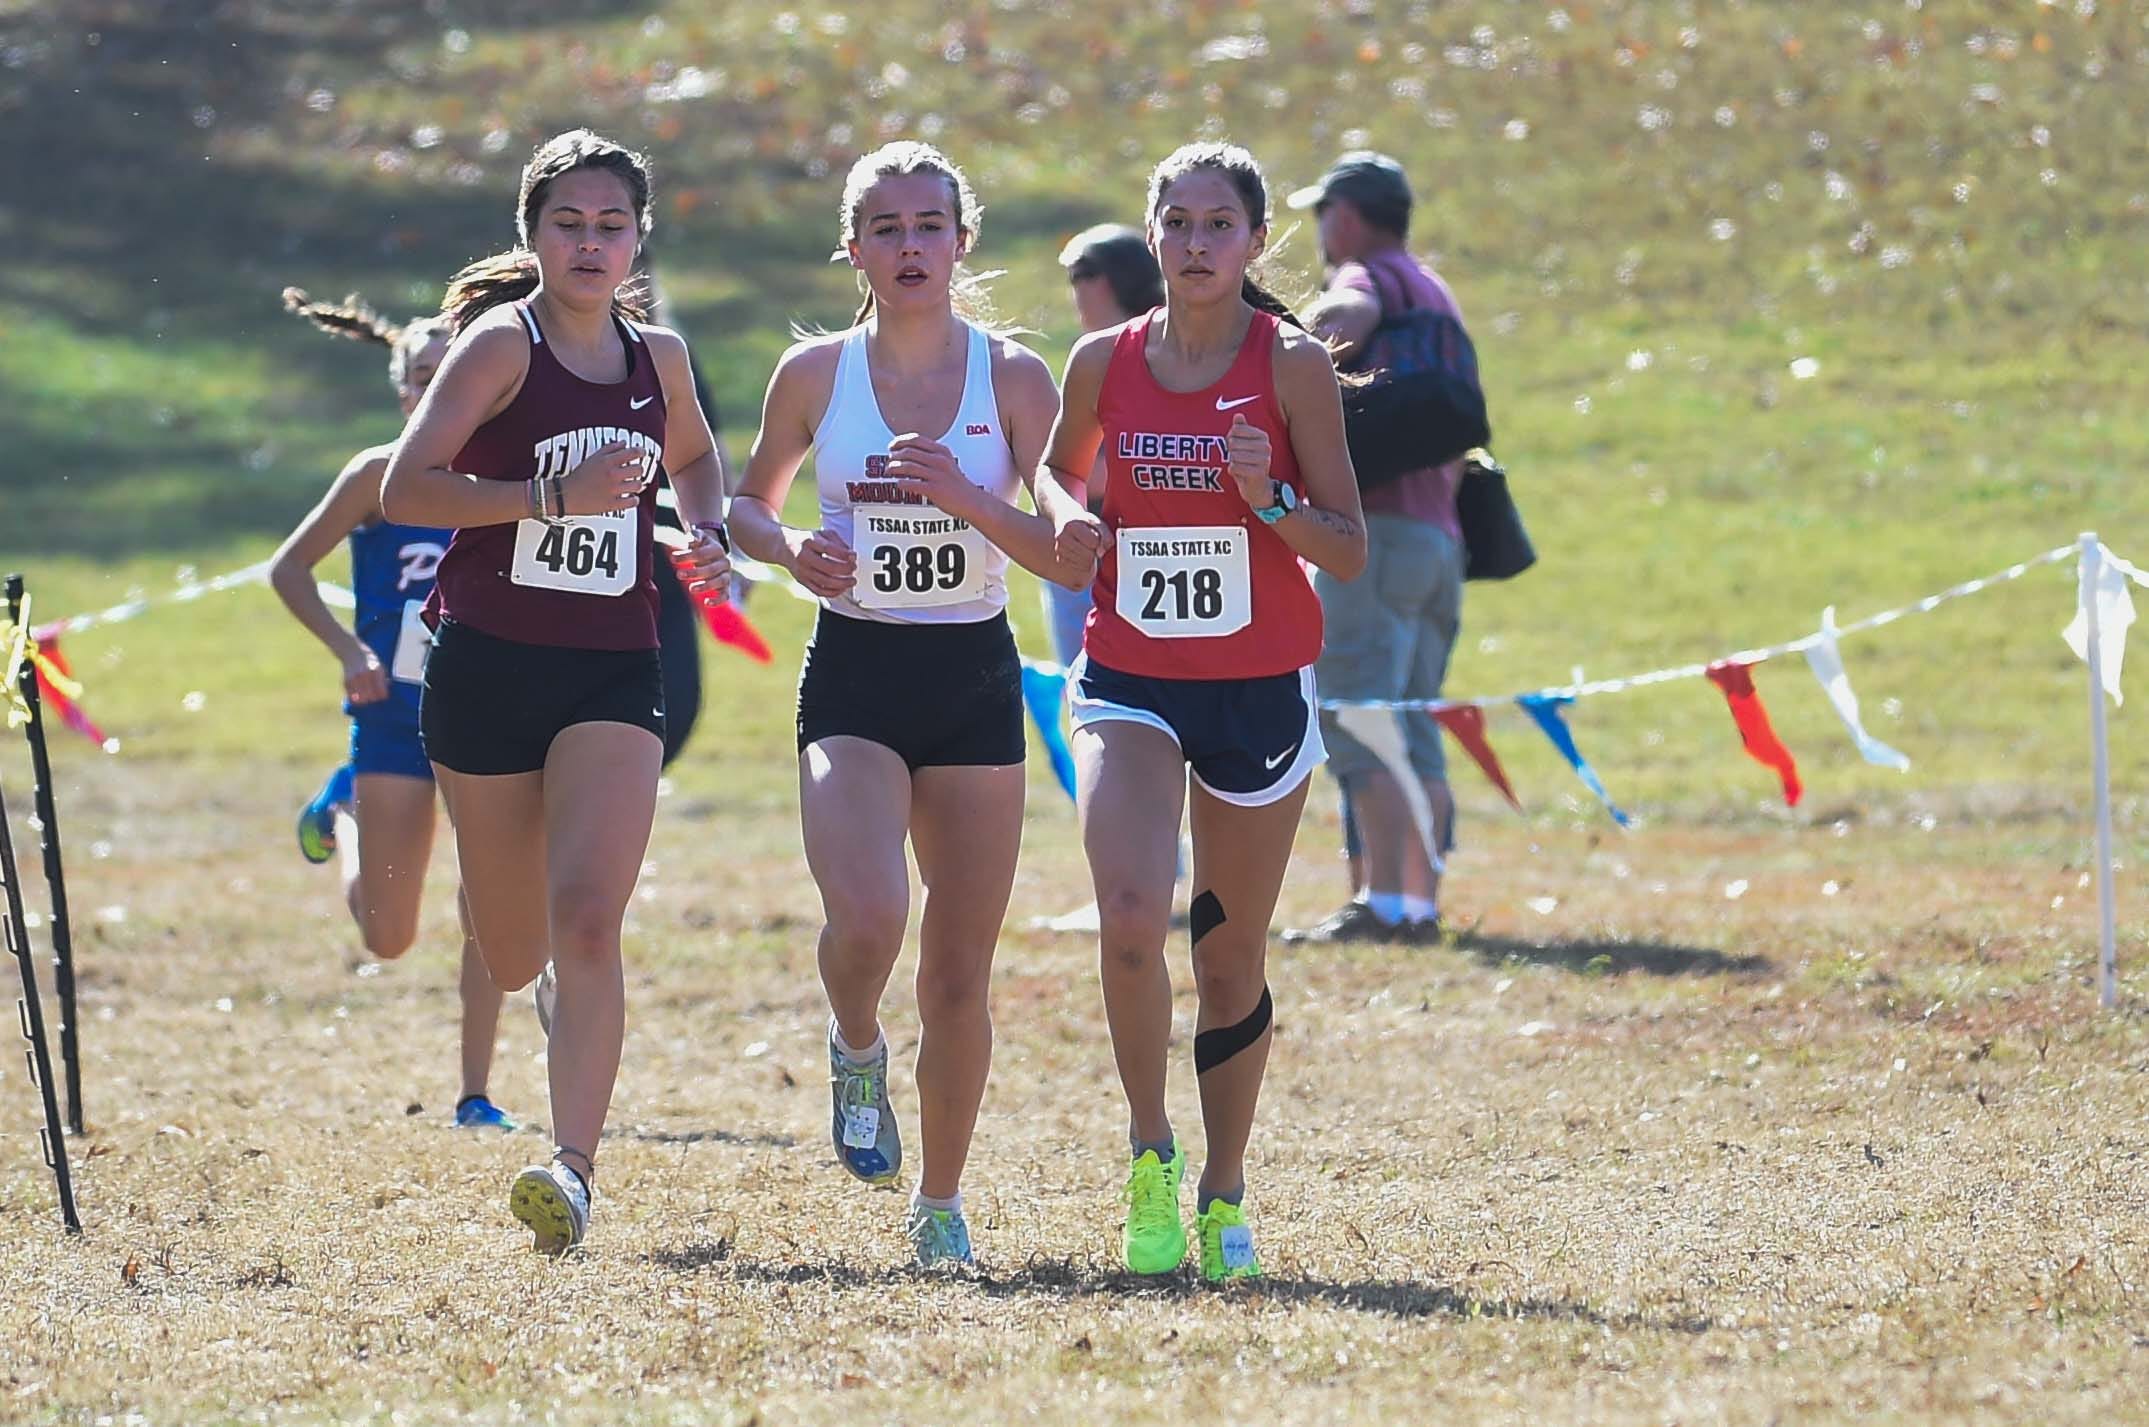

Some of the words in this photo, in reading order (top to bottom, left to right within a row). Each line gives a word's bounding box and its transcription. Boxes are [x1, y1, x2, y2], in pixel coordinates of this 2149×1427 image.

[1118, 432, 1231, 463] LIBERTY
[1132, 464, 1224, 492] CREEK
[868, 517, 911, 533] TSSAA
[912, 519, 951, 535] STATE
[535, 525, 618, 579] 464
[1130, 541, 1169, 557] TSSAA
[1171, 540, 1212, 557] STATE
[1214, 540, 1232, 555] XC
[872, 543, 966, 593] 389
[1141, 568, 1223, 620] 218
